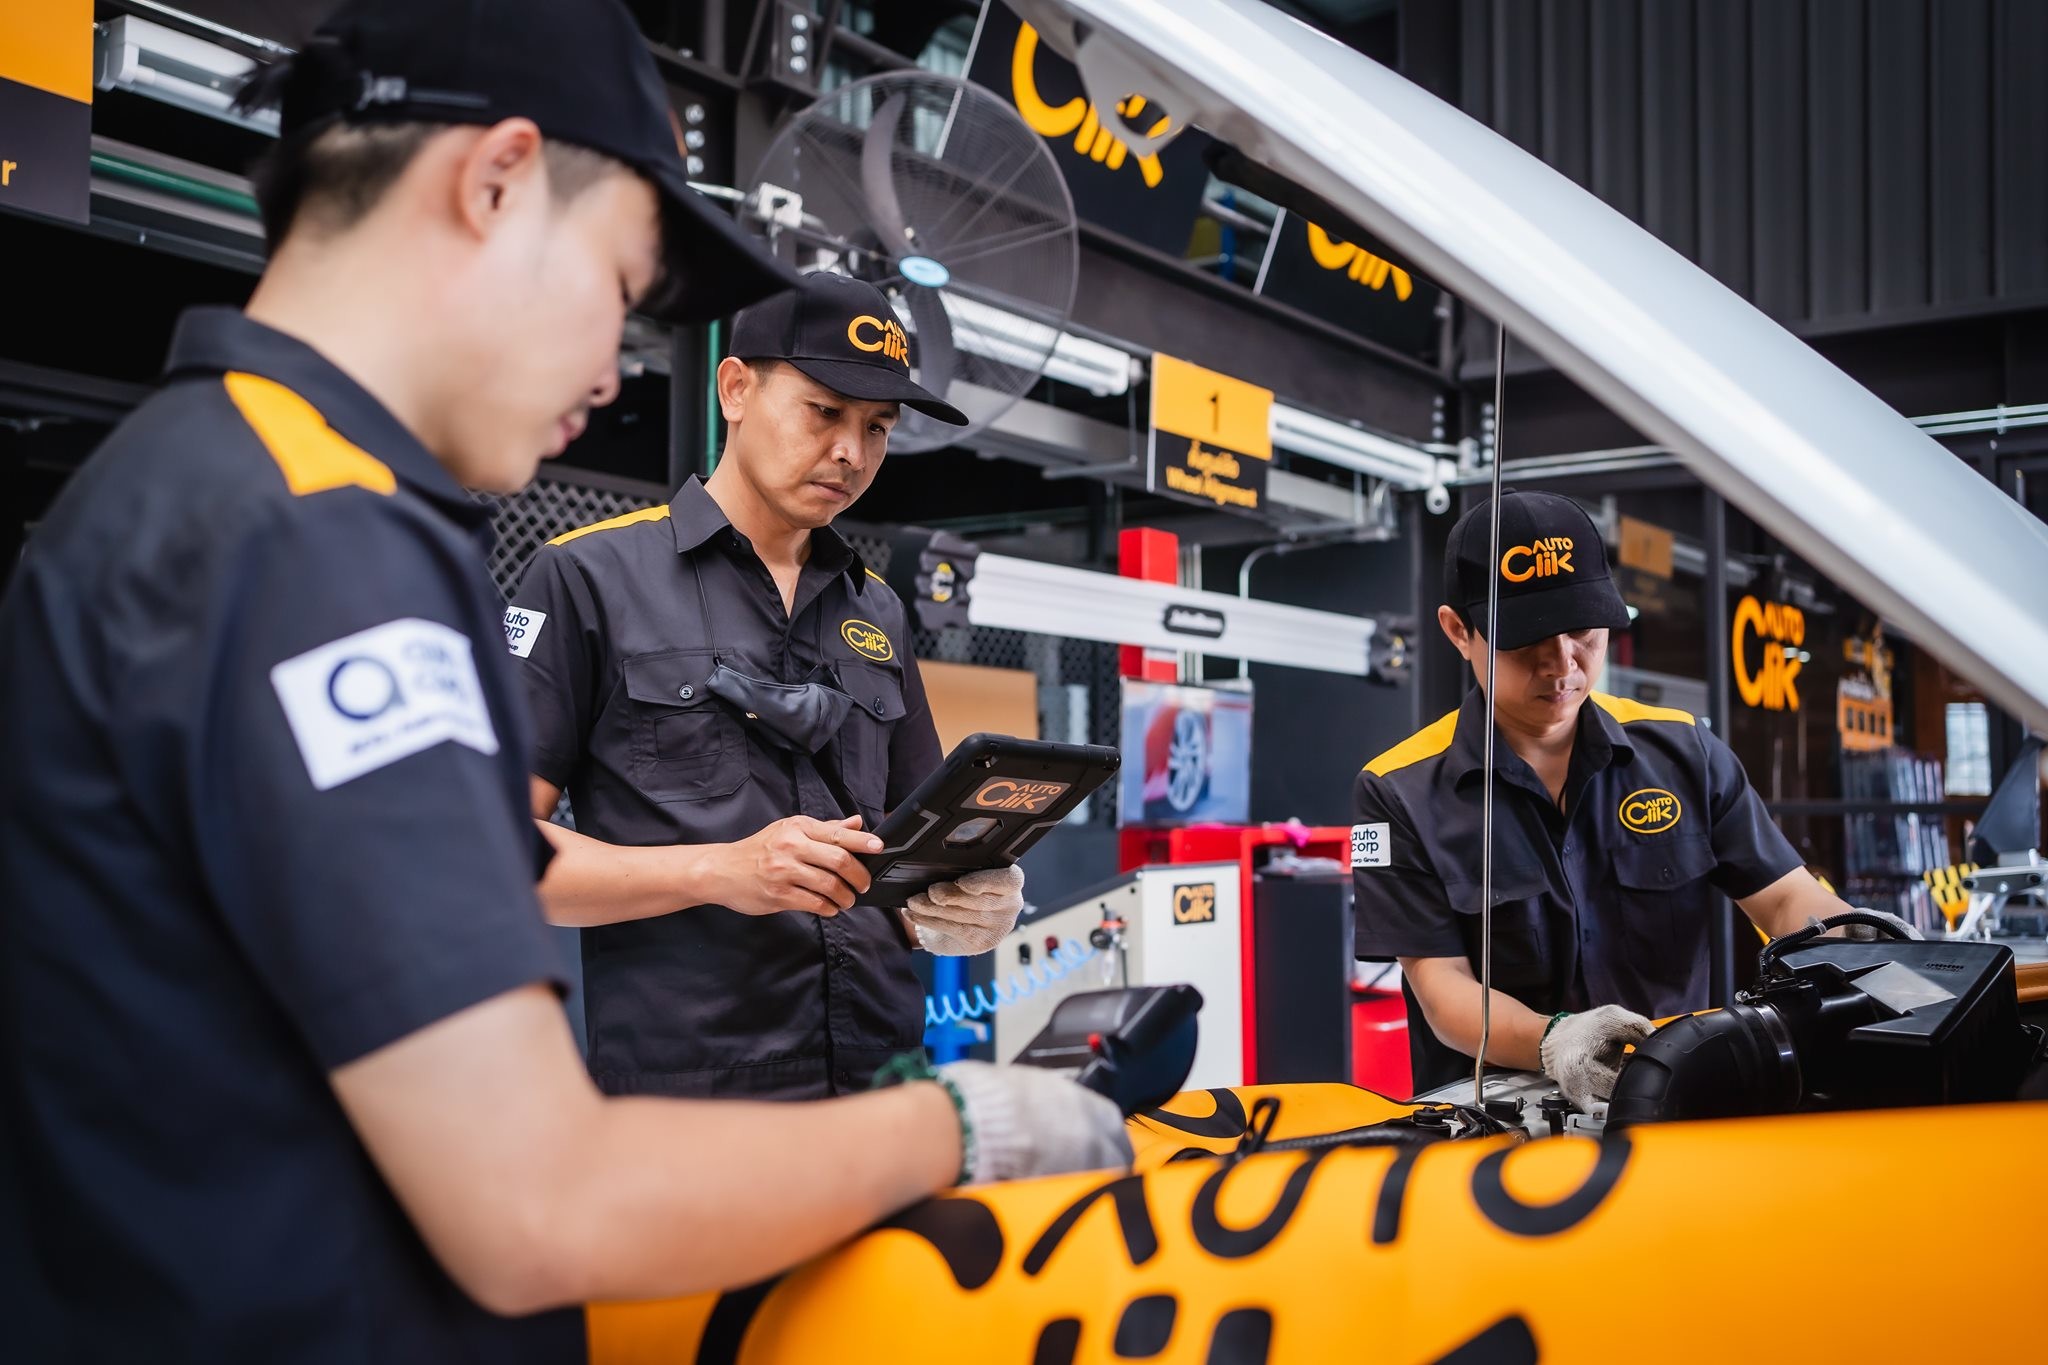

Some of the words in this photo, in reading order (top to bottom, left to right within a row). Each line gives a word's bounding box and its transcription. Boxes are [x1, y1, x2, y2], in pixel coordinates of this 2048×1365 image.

[848, 315, 909, 367] Clik
[1210, 392, 1220, 433] 1
[1533, 537, 1574, 555] AUTO
[1500, 545, 1575, 583] Clik
[863, 631, 886, 643] AUTO
[1763, 601, 1805, 647] AUTO
[847, 627, 887, 655] Clik
[1732, 595, 1802, 713] Clik
[976, 781, 1047, 810] Clik
[1016, 783, 1062, 795] AUTO
[1645, 797, 1673, 809] AUTO
[1626, 802, 1673, 825] Clik
